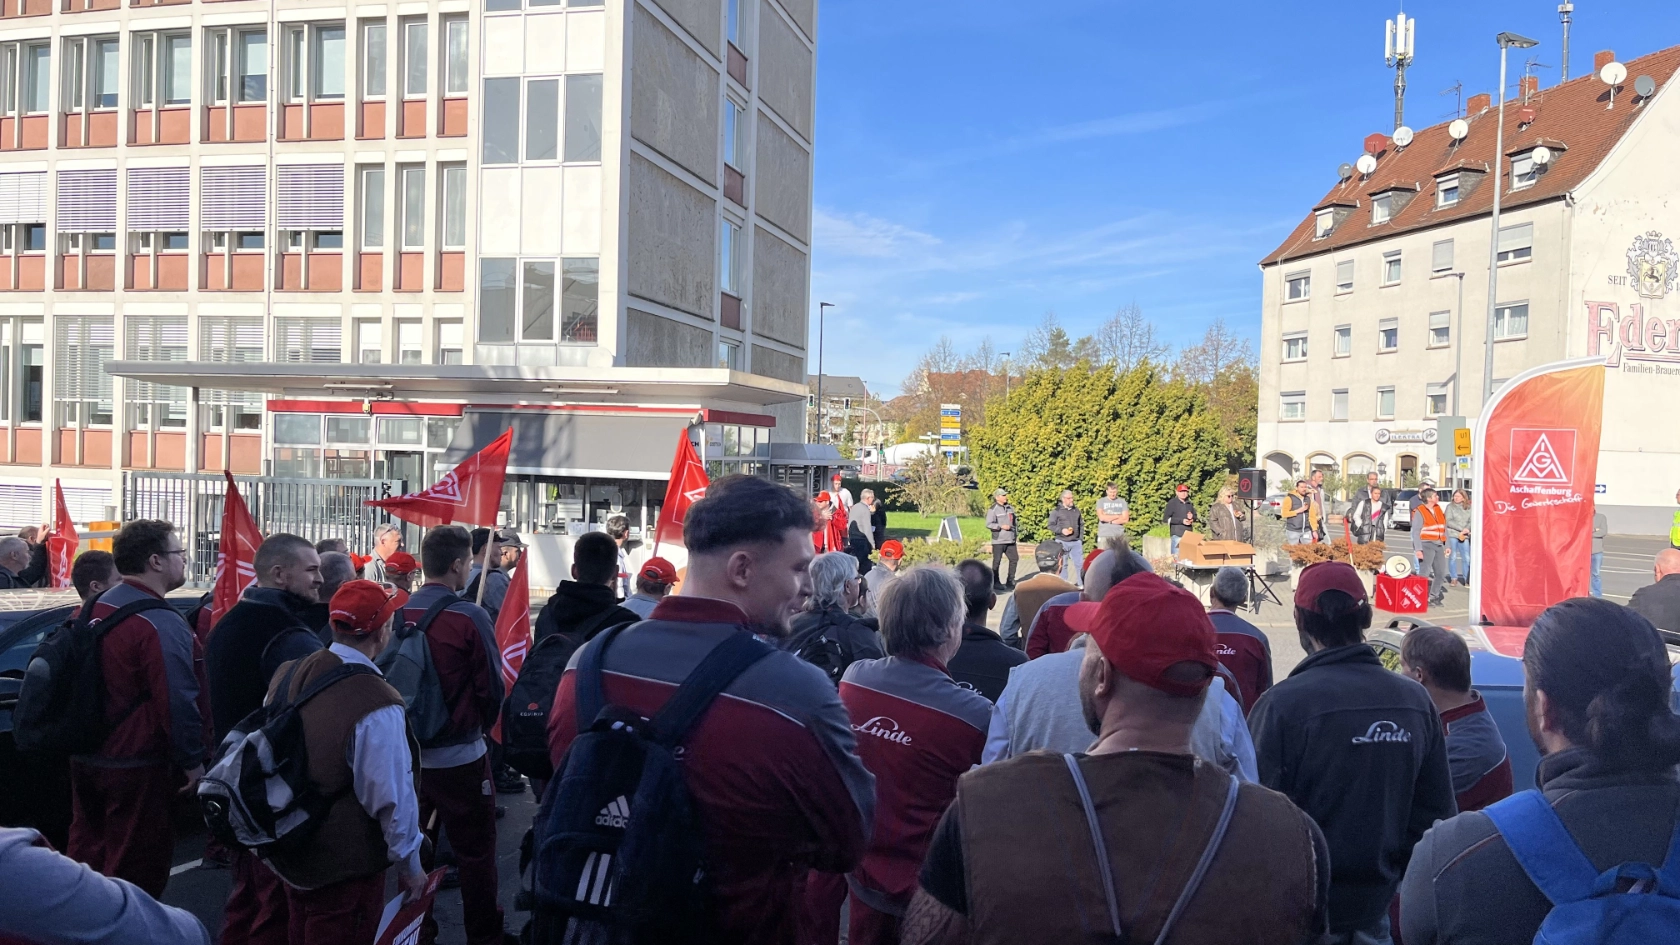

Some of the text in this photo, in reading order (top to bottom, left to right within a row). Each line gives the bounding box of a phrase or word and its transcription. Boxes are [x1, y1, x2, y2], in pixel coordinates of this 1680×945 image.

[1608, 275, 1627, 286] SEIT
[1509, 485, 1572, 497] Aschaffenburg
[1493, 500, 1516, 514] Die
[850, 716, 912, 746] Linde
[1351, 720, 1412, 743] Linde
